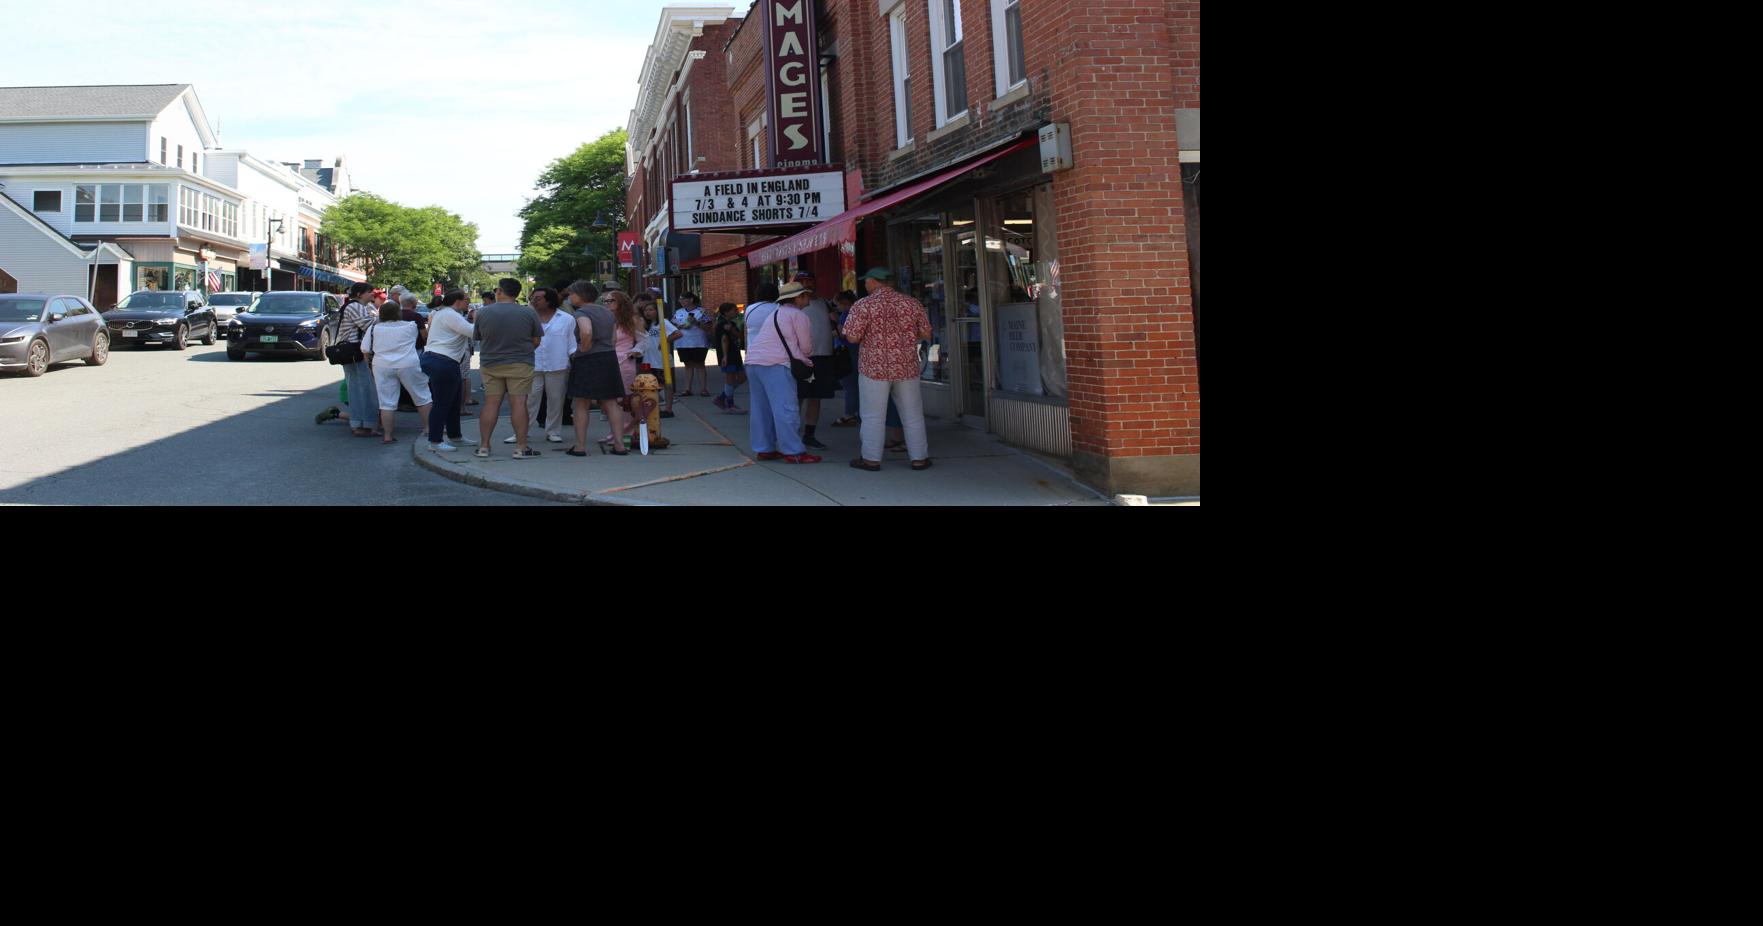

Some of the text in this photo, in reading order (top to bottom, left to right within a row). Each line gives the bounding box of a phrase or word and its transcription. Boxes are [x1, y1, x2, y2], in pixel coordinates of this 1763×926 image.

[775, 1, 809, 150] MAGES
[704, 178, 810, 197] A FIELD IN ENGLAND
[695, 192, 821, 211] 7/3 & 4 AT 9:30 PM
[692, 206, 819, 224] SUNDANCE SHORTS 7/4
